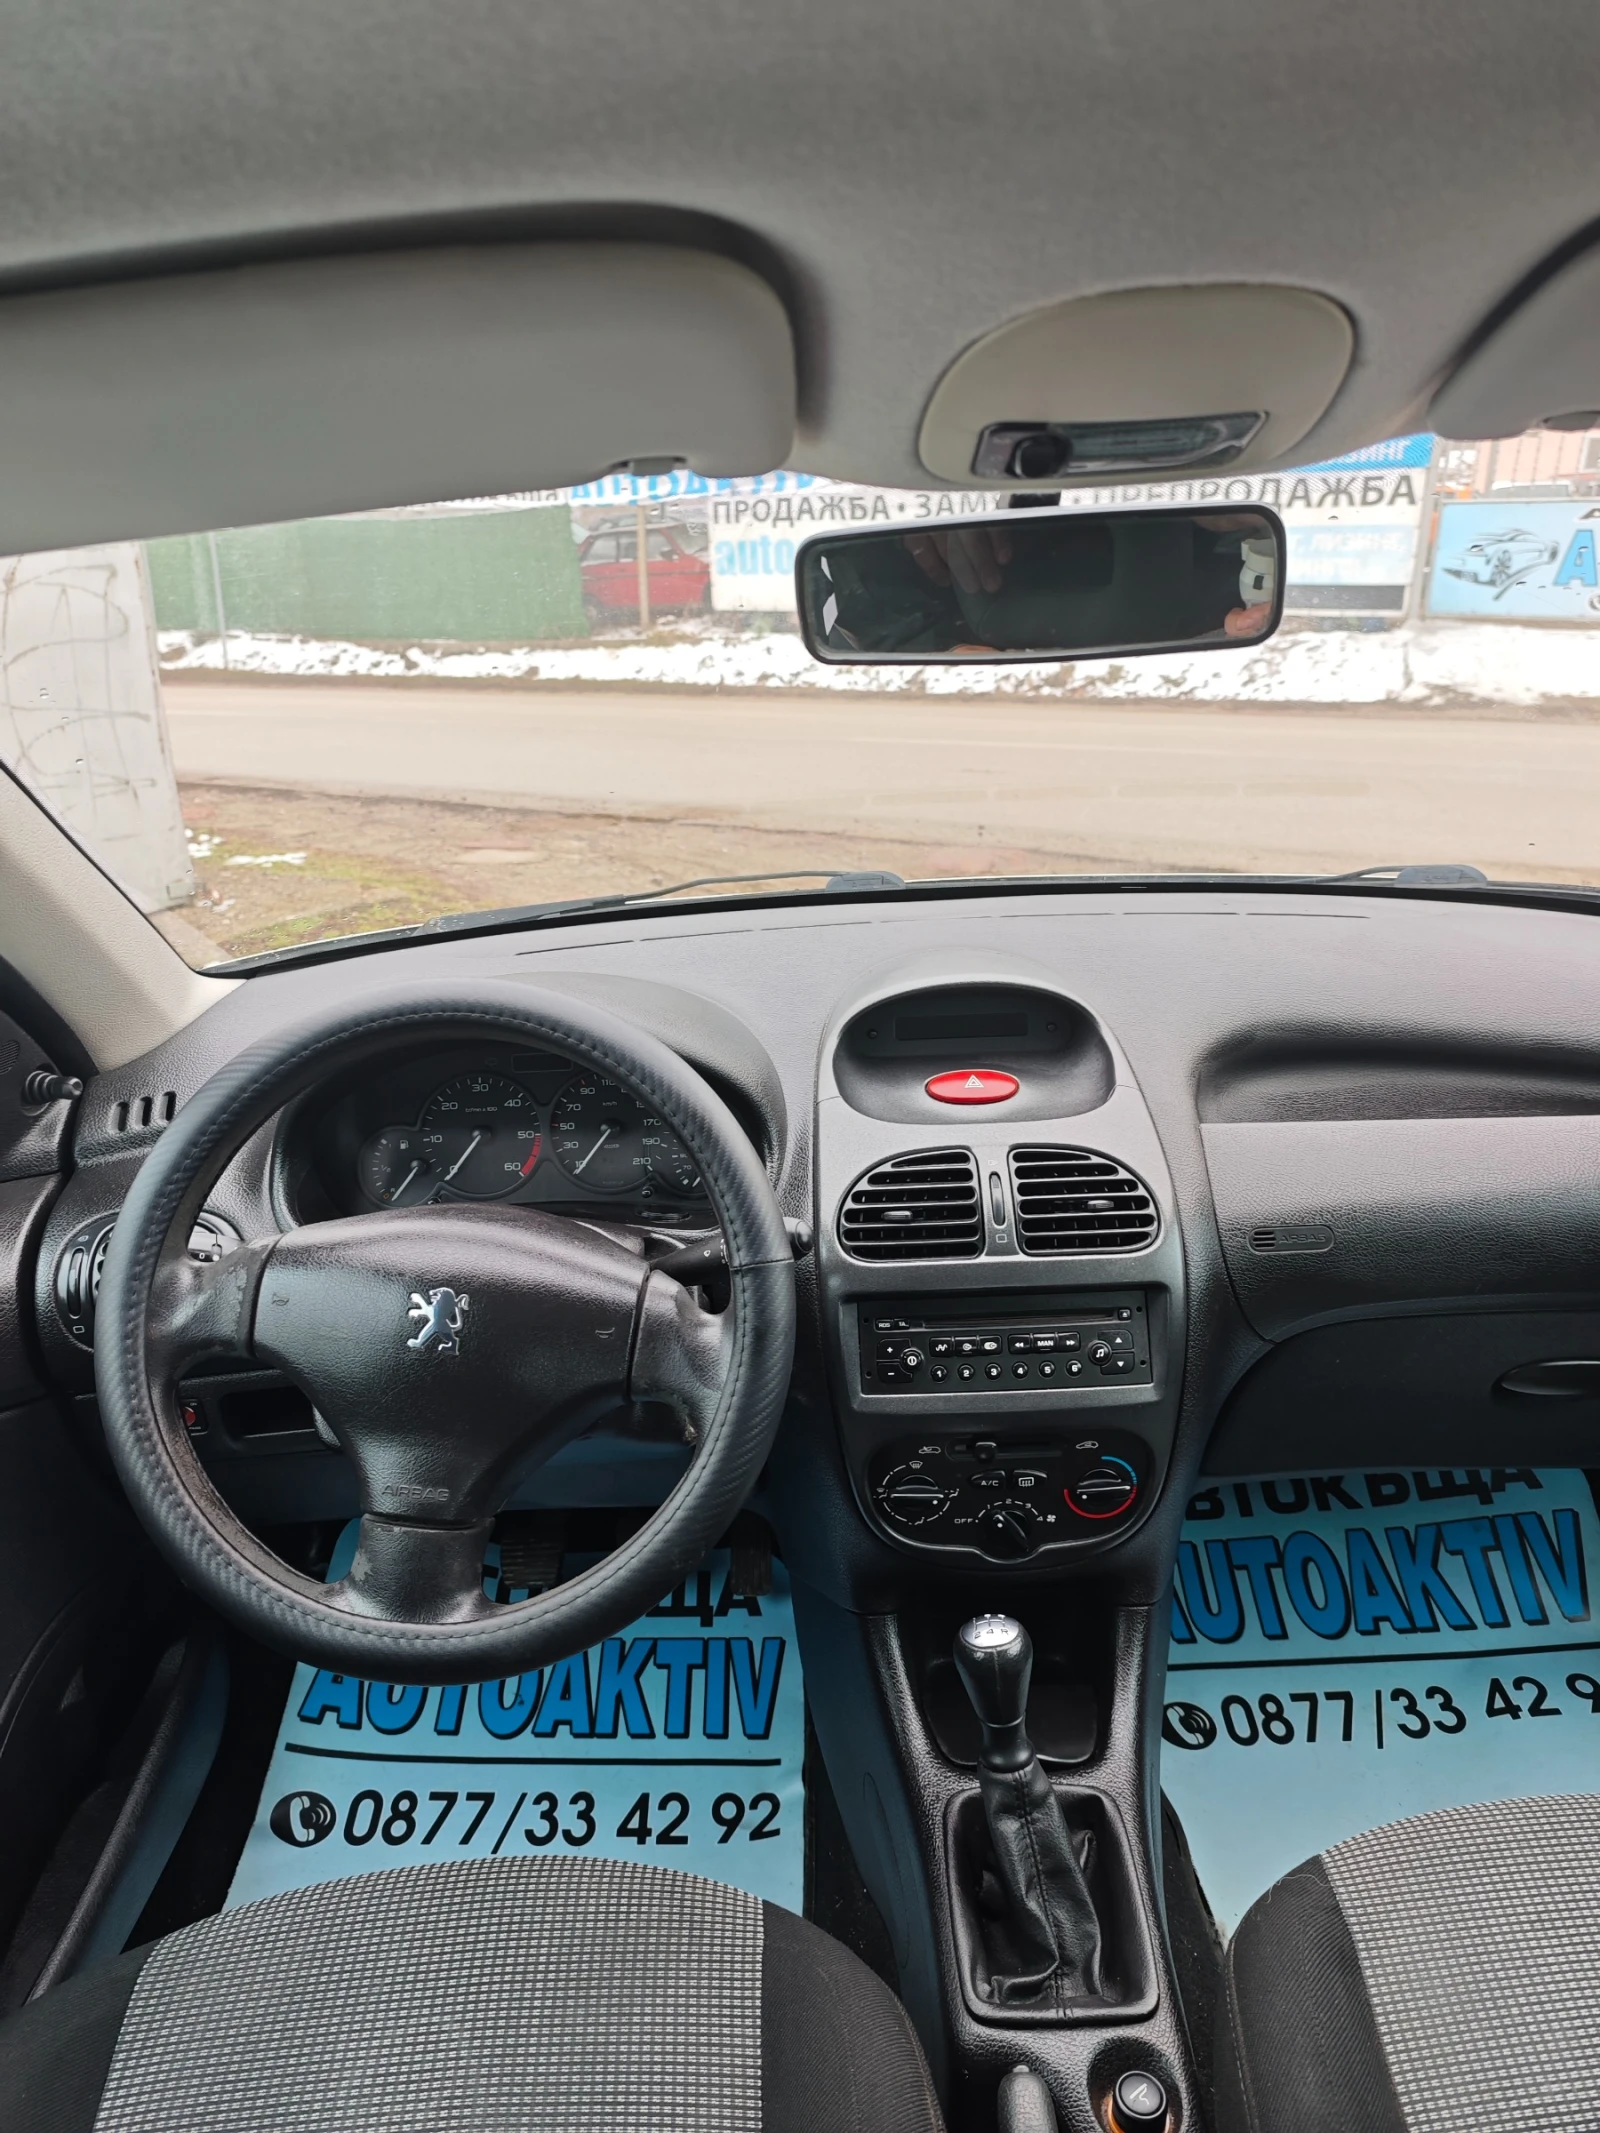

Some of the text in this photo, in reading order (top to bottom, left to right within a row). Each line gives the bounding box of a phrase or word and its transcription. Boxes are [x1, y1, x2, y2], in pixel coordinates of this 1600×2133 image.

[712, 494, 890, 526] ПРОДАЖБА
[913, 493, 1001, 519] ЗАМ
[472, 1083, 489, 1092] 30
[580, 1087, 596, 1095] 90
[441, 1102, 459, 1110] 20
[504, 1099, 522, 1107] 40
[560, 1122, 575, 1130] 50
[430, 1134, 443, 1143] 10
[517, 1131, 535, 1139] 50
[563, 1141, 579, 1149] 30
[642, 1137, 661, 1145] 190
[633, 1157, 652, 1165] 210
[504, 1162, 521, 1171] 60
[936, 1365, 1078, 1378] 1 2 3 4 5 6
[381, 1483, 450, 1502] AIRBAG
[1484, 1676, 1562, 1721] 42
[343, 1789, 782, 1854] 0877/33 42 92
